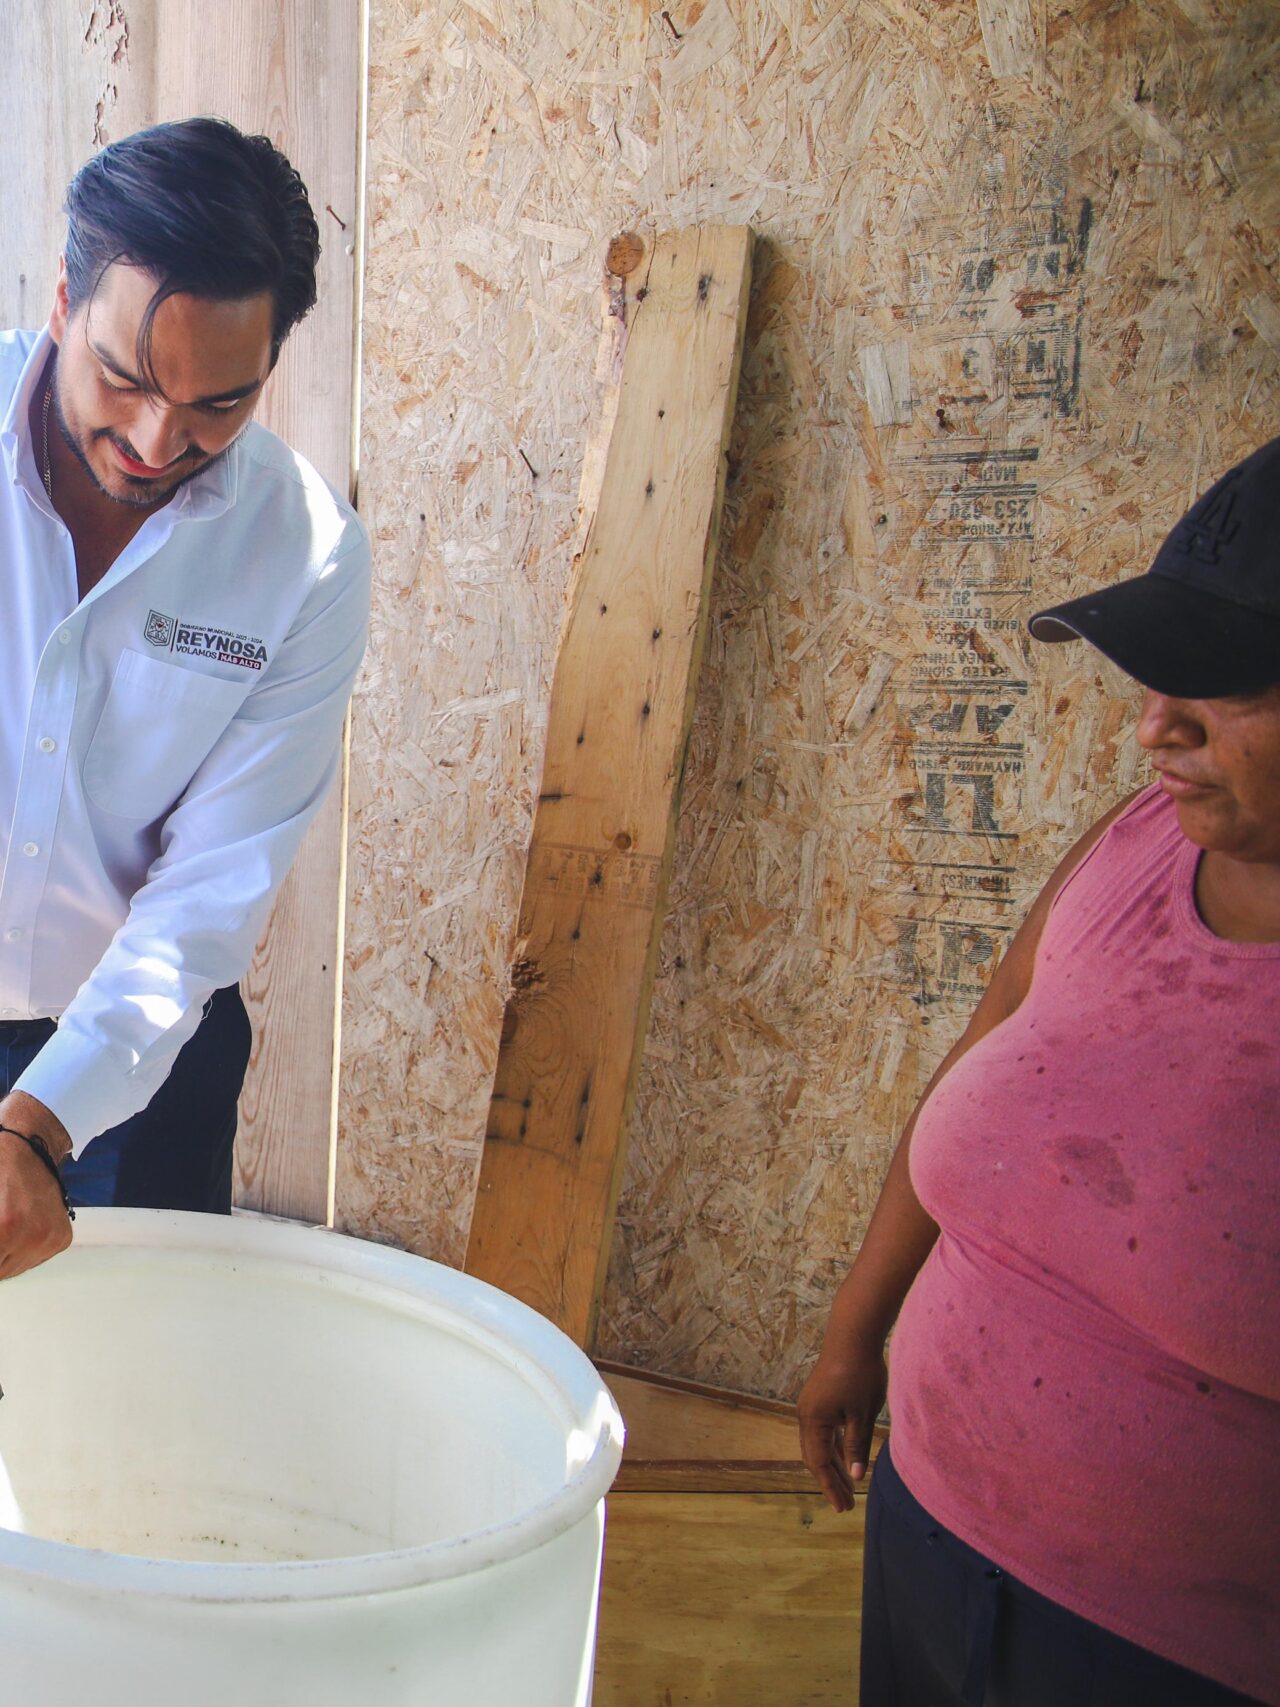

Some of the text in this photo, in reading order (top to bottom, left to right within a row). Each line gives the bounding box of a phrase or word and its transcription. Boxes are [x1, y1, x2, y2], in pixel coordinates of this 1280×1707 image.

[176, 629, 268, 662] REYNOSA
[176, 644, 218, 661] VOLAMOS
[240, 659, 261, 670] ALTO
